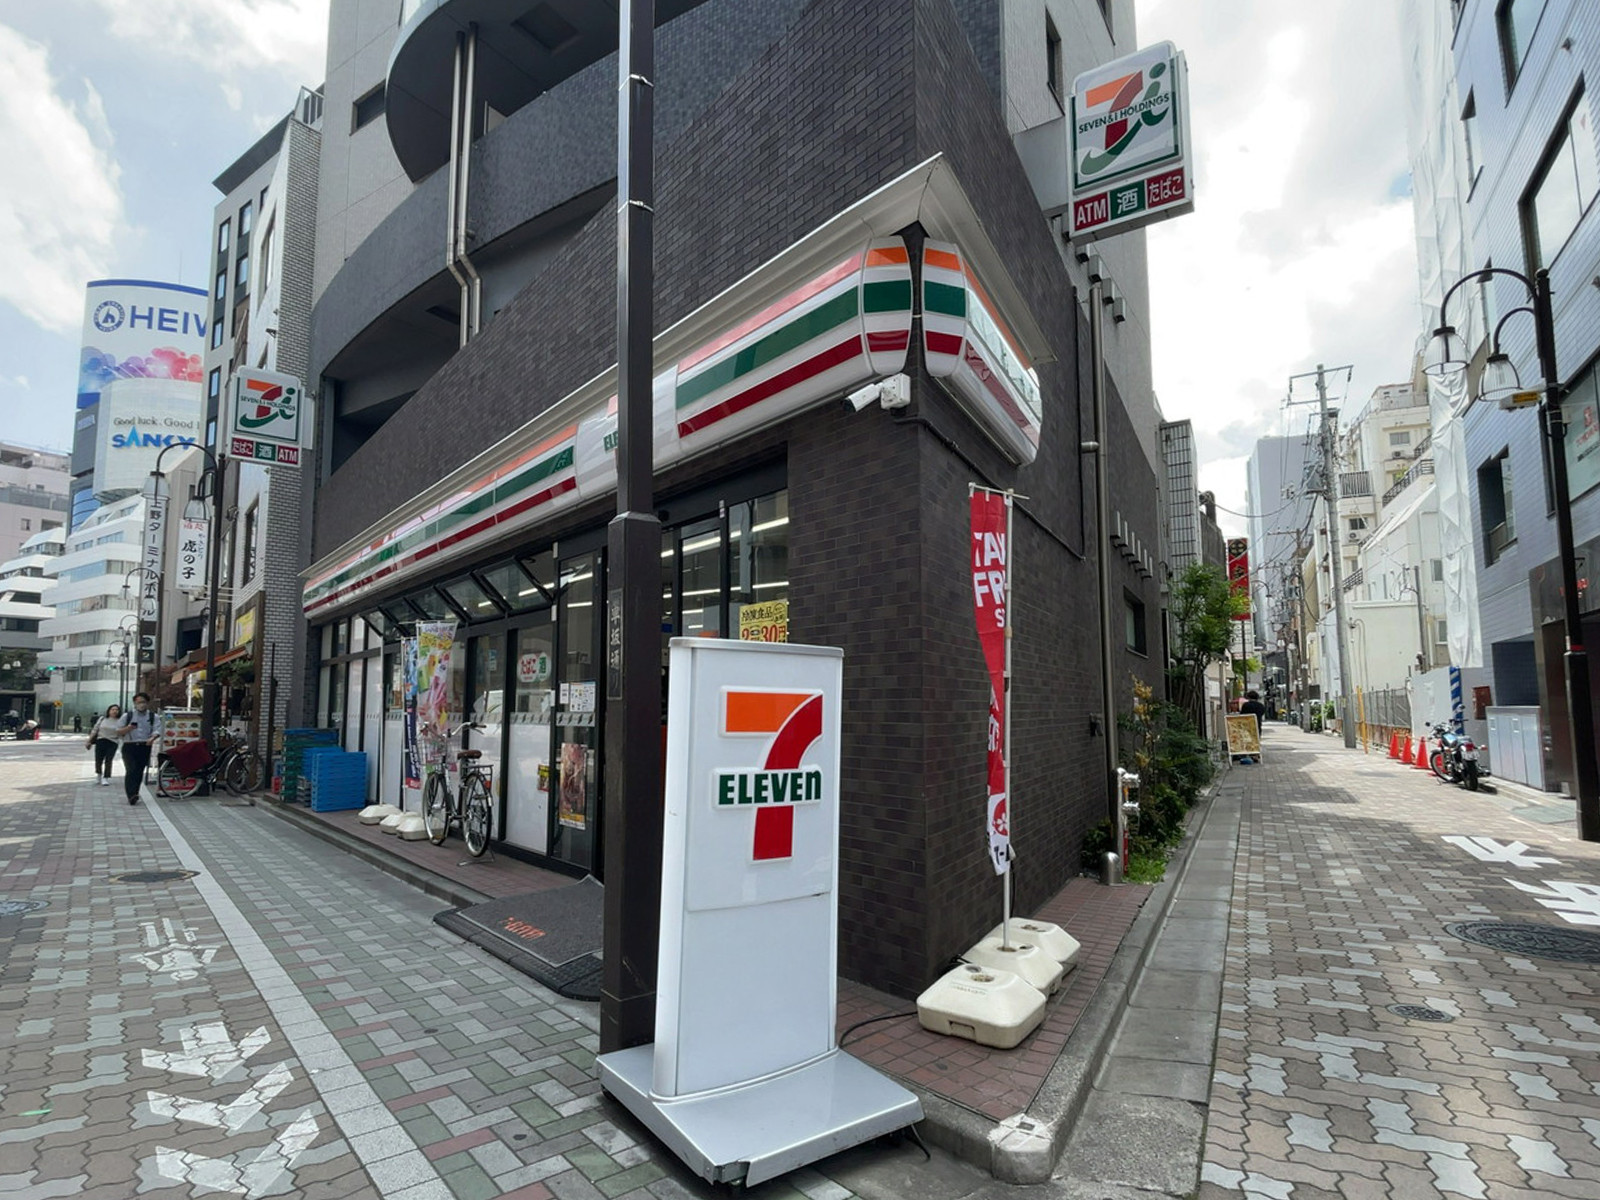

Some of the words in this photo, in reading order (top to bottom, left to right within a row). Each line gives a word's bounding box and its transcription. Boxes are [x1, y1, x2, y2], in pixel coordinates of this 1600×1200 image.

[1119, 93, 1170, 119] HOLDINGS
[1076, 198, 1106, 226] ATM
[1116, 187, 1139, 215] 酒
[1148, 175, 1184, 203] たばこ
[113, 417, 135, 427] Good
[164, 418, 193, 429] Good
[232, 440, 253, 455] たばこ
[258, 444, 273, 458] 酒
[278, 447, 297, 462] ATM
[142, 501, 162, 616] 上野ターミナルホル
[182, 539, 196, 579] 虎の子
[973, 569, 1005, 608] FR
